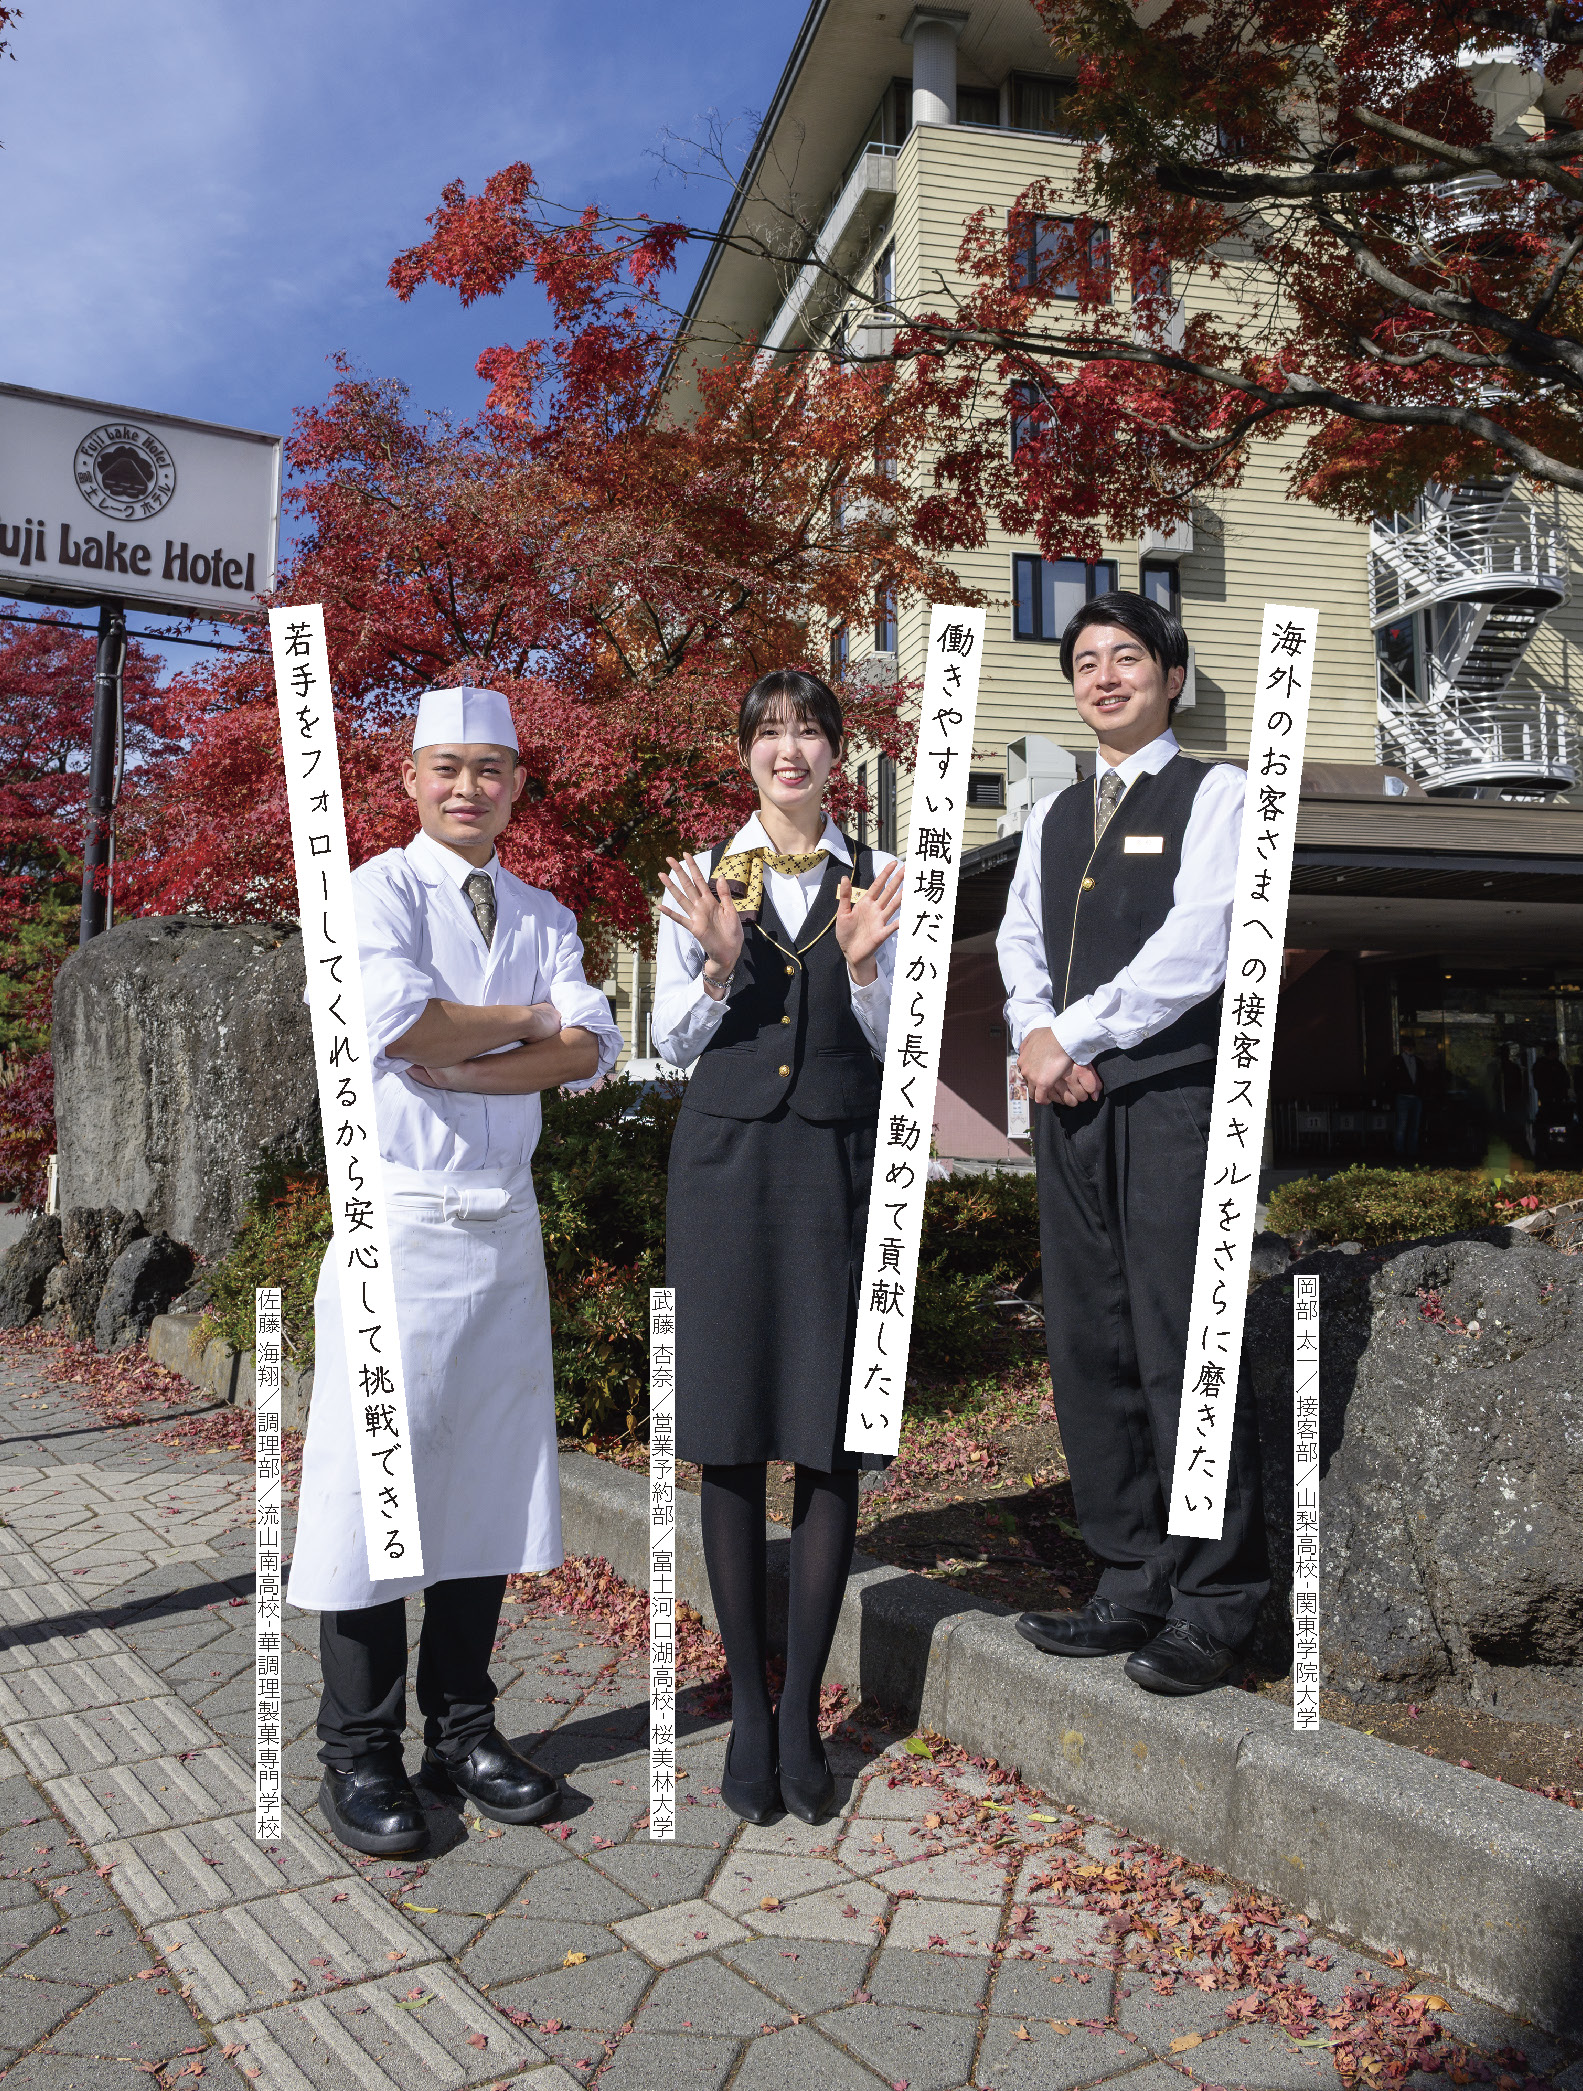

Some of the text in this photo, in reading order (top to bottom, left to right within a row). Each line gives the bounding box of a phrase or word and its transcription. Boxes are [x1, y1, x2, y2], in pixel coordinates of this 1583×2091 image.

[81, 426, 171, 469] Fuji Lake Hotel
[0, 514, 255, 592] uji Lake Hotel
